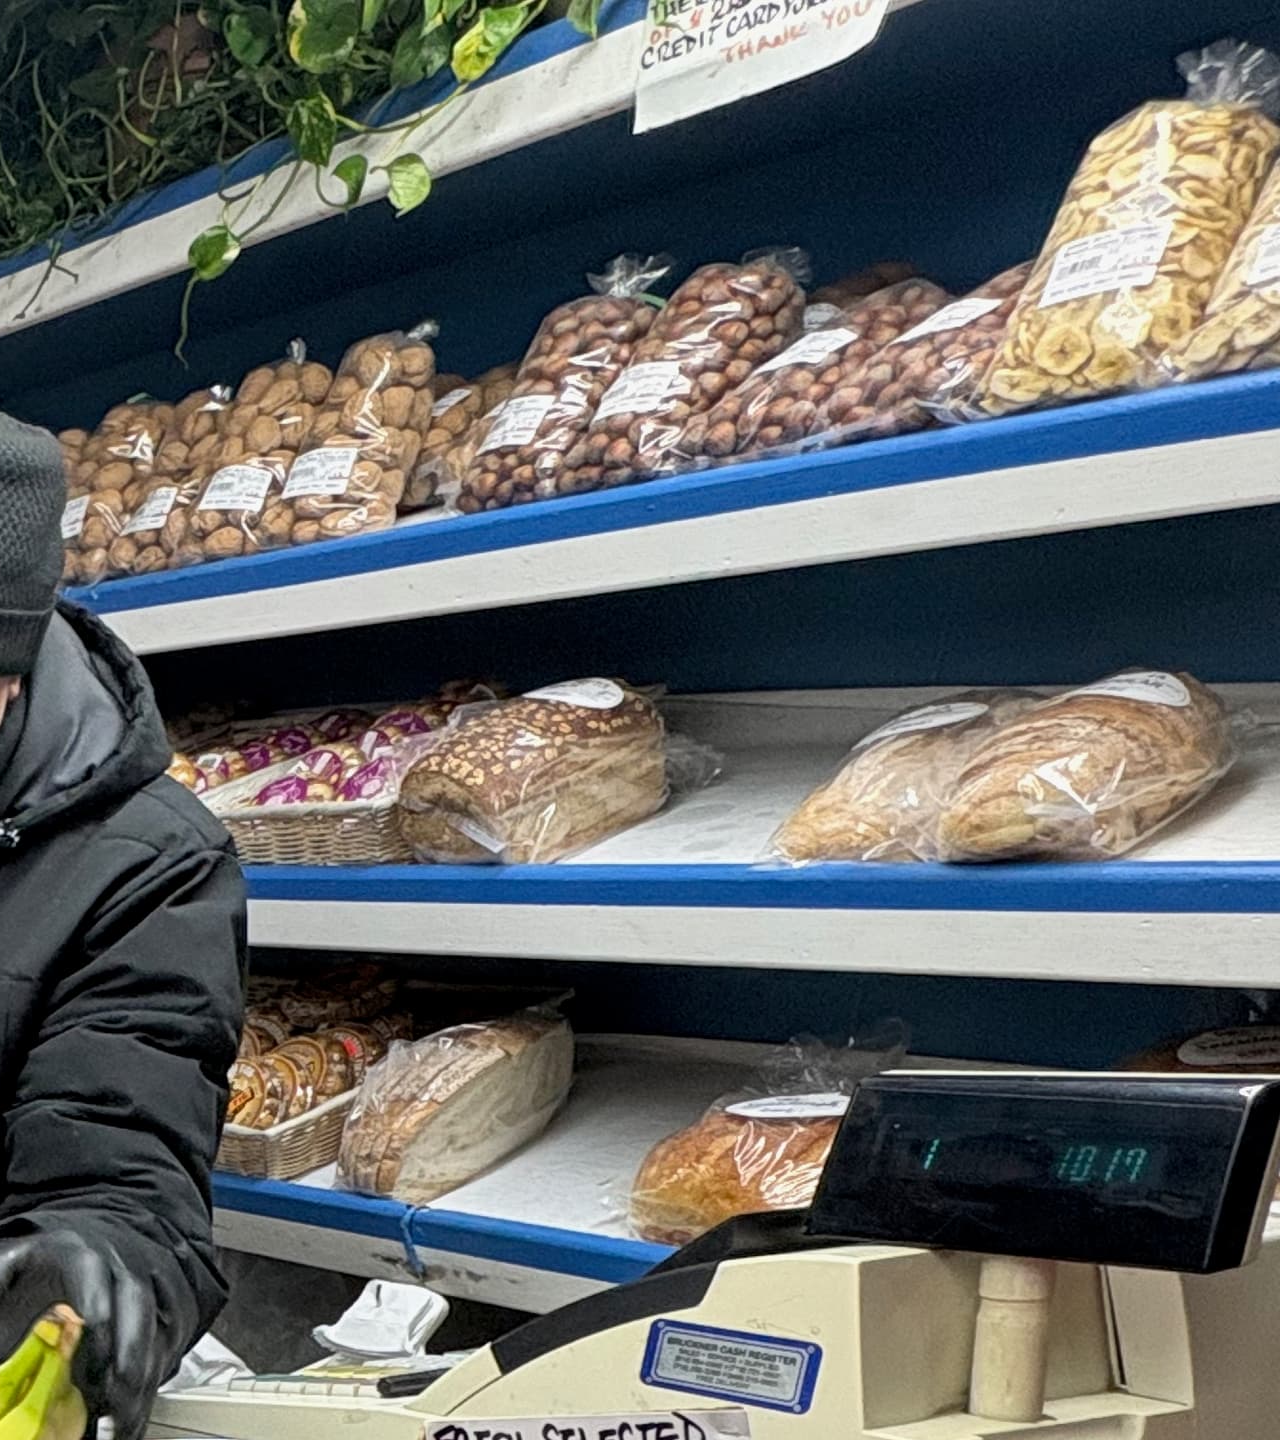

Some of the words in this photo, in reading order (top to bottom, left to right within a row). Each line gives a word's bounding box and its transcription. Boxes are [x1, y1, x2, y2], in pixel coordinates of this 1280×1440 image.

[640, 21, 722, 70] CREDIT
[725, 4, 779, 38] CARD
[719, 22, 810, 64] THANK
[821, 0, 874, 30] YOU
[719, 1344, 747, 1357] CASH
[747, 1349, 798, 1367] REGISTER
